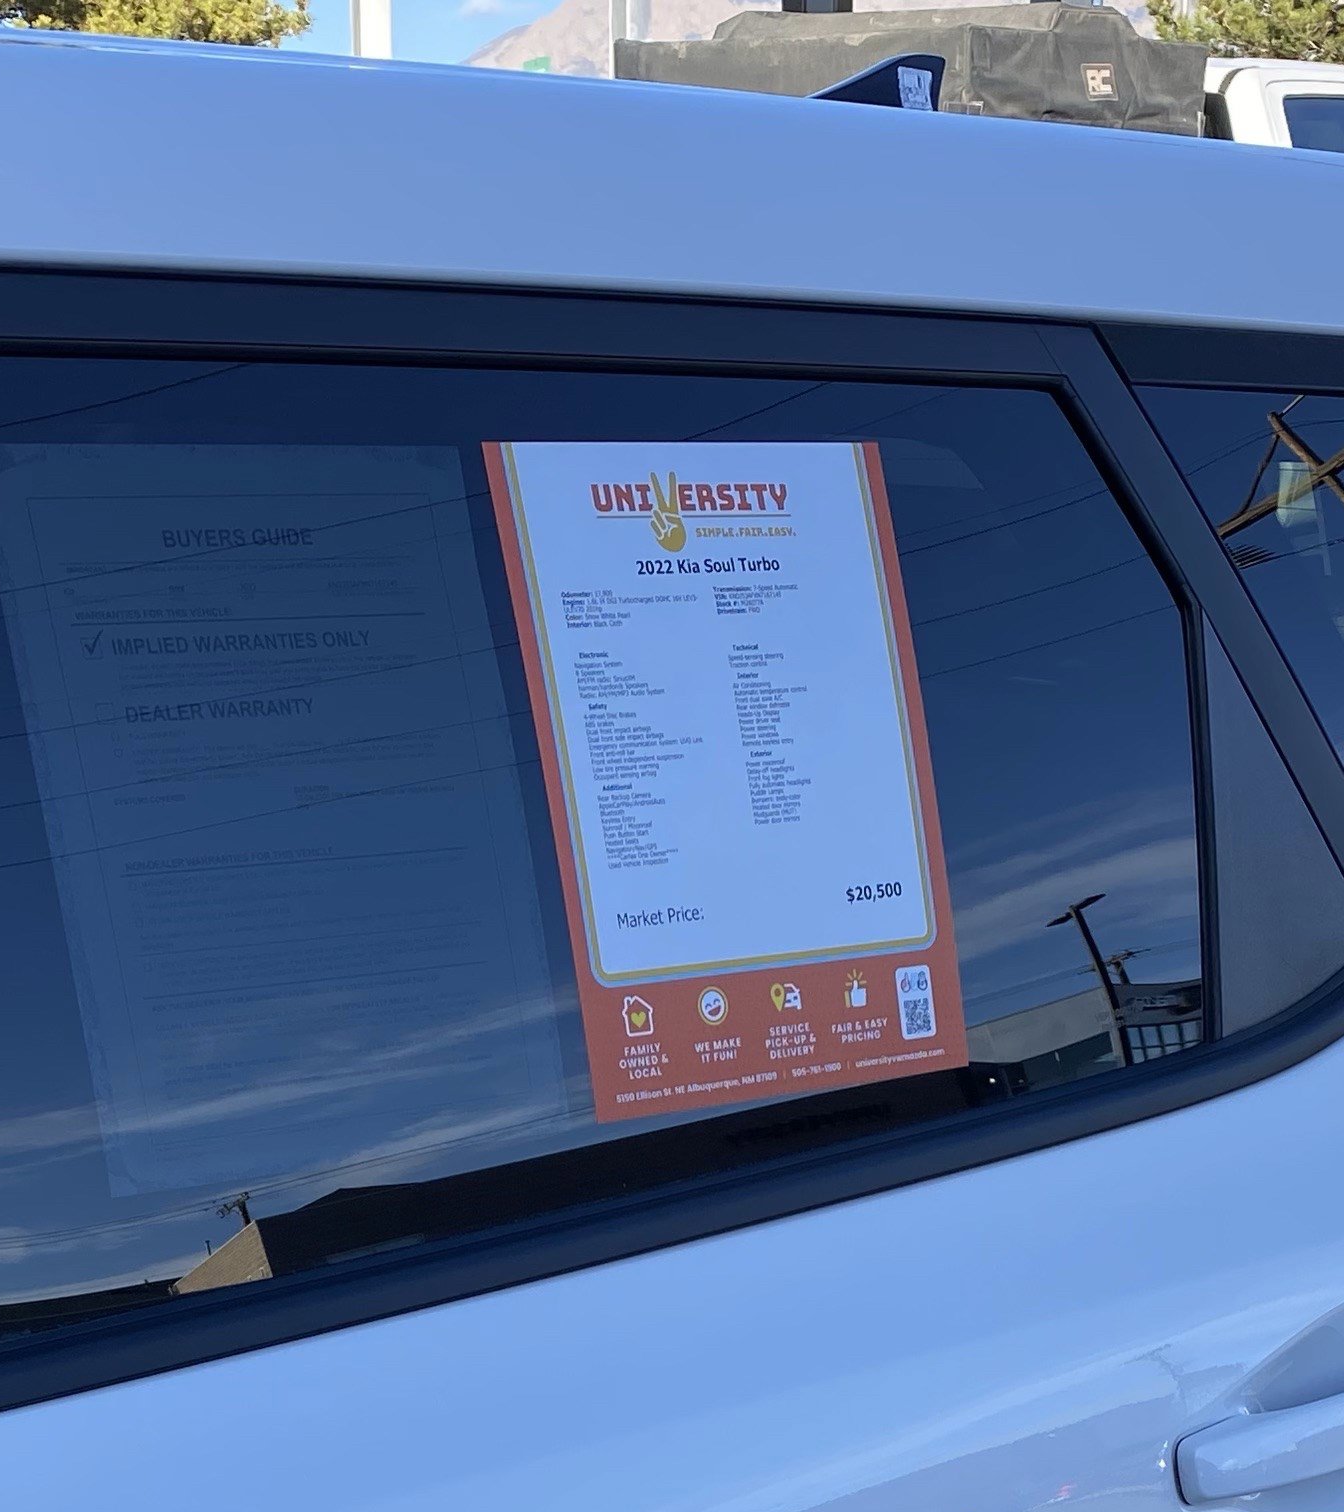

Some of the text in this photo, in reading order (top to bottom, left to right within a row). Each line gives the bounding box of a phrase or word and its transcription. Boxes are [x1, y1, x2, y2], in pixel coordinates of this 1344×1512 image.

[590, 471, 788, 513] UNIVERSITY
[162, 527, 314, 548] BUYERS GUIDE
[636, 556, 780, 576] 2022 Kia Soul Turbo
[111, 629, 371, 655] IMPLIED WARRANTIES ONLY
[579, 650, 609, 659] Electronic
[125, 697, 314, 723] DEALER WARRANTY
[588, 703, 607, 711] Safety
[750, 750, 772, 758] Exterior
[602, 783, 632, 792] Additional
[846, 881, 902, 904] $20,500
[617, 906, 704, 929] Market Price:
[769, 1022, 810, 1036] SERVICE
[832, 1018, 888, 1034] FAIR & EASY
[765, 1033, 817, 1049] PICK-UP &
[841, 1030, 881, 1044] PRICING
[624, 1043, 661, 1056] FAMILY
[695, 1037, 741, 1053] WE MAKE
[769, 1045, 815, 1060] DELIVERY
[619, 1054, 669, 1069] OWNED &
[701, 1050, 738, 1064] IT FUN!
[629, 1068, 662, 1080] LOCAL
